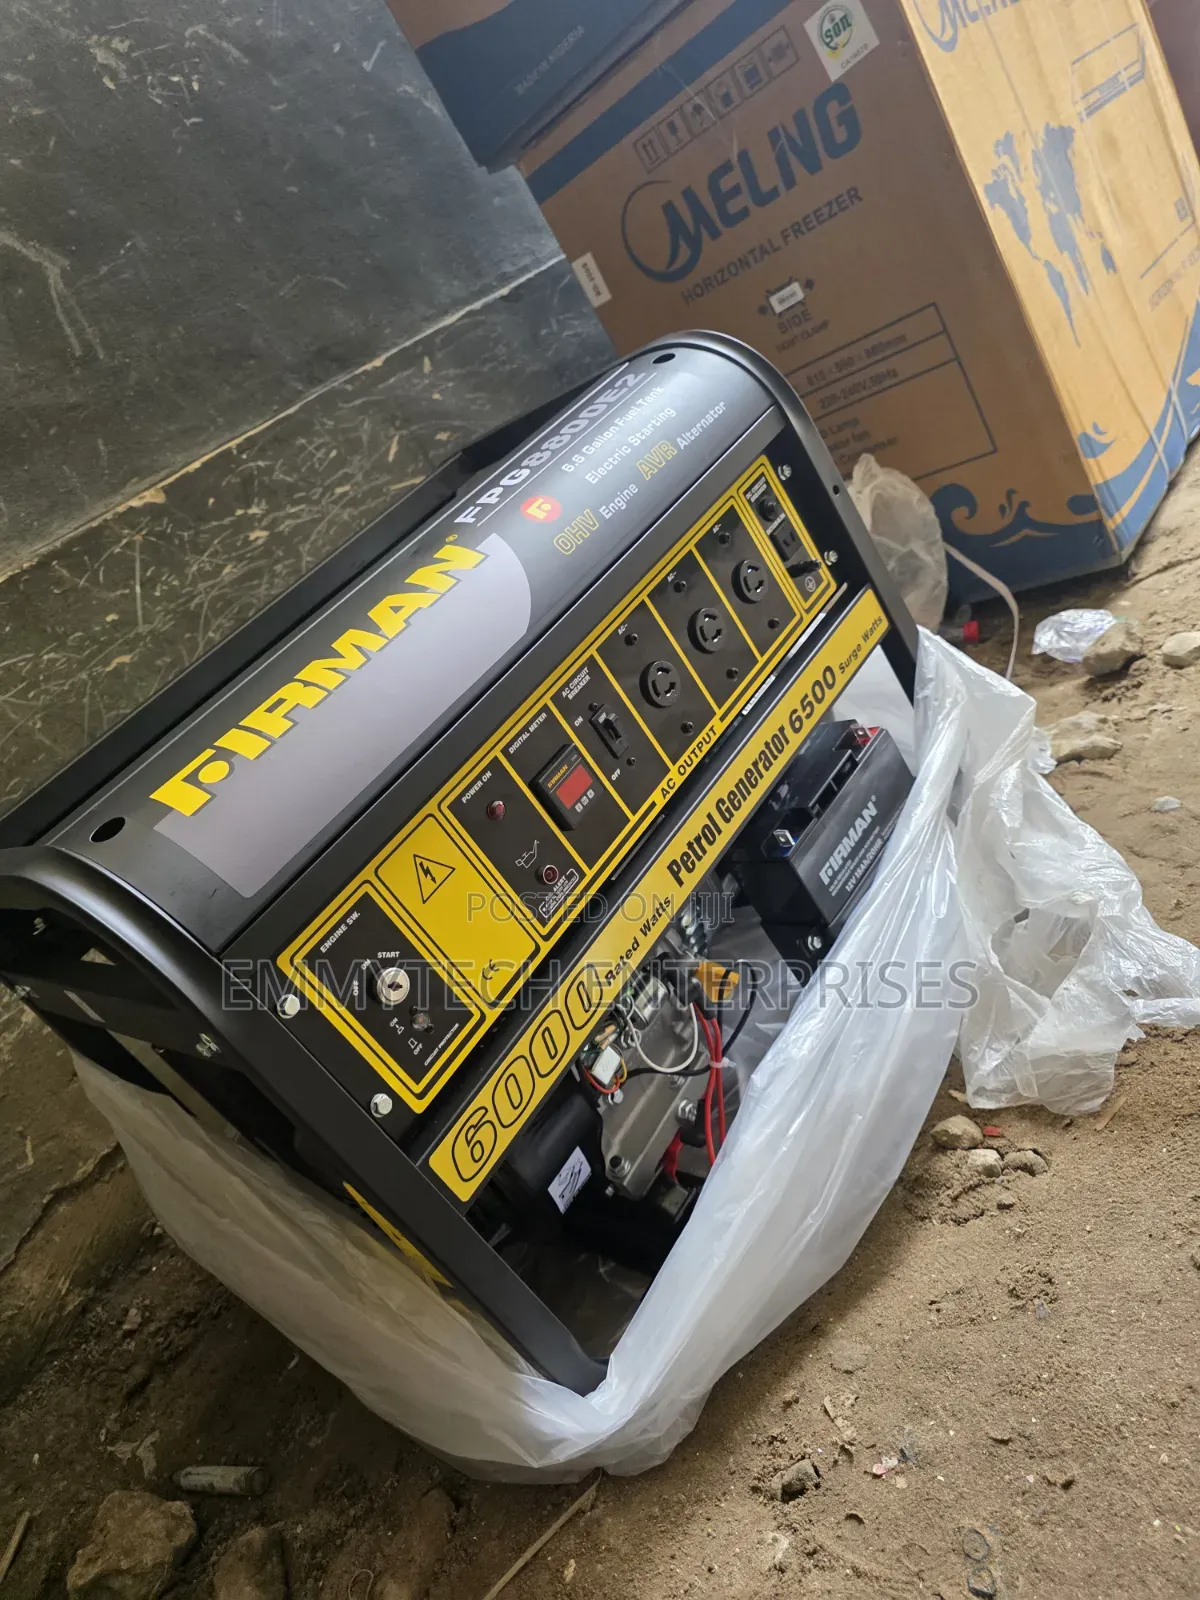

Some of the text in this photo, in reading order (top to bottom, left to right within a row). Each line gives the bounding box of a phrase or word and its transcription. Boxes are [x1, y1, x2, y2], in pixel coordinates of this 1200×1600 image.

[681, 186, 863, 305] HORIZONTAL FREEZER
[778, 308, 813, 334] SIDE
[582, 426, 619, 455] Gallon
[614, 406, 640, 427] Fuel
[635, 386, 665, 407] Tank
[454, 371, 648, 525] FPG8800E2
[584, 407, 677, 484] Electric Starting
[553, 401, 727, 555] OHV Engine AVR Alternator
[149, 544, 489, 817] FIRMAN
[561, 667, 590, 698] AC CIRCUIT
[567, 675, 591, 700] BREAKER
[508, 712, 547, 754] DIGITAL METER
[574, 716, 584, 727] ON
[611, 768, 621, 781] OFF
[660, 725, 717, 800] AC OUTPUT
[461, 770, 492, 804] POWER ON
[819, 801, 878, 886] FIRMAN
[452, 963, 604, 1183] 6000
[604, 936, 641, 987] Rated
[639, 896, 671, 936] Watts
[667, 816, 723, 888] Petrol
[715, 724, 791, 825] Generator
[788, 665, 837, 735] 6500
[861, 615, 883, 644] Watts
[320, 911, 361, 953] ENGINE SW.
[361, 958, 371, 971] ON
[377, 951, 400, 959] START
[390, 1017, 398, 1028] ON
[413, 1042, 423, 1056] OFF
